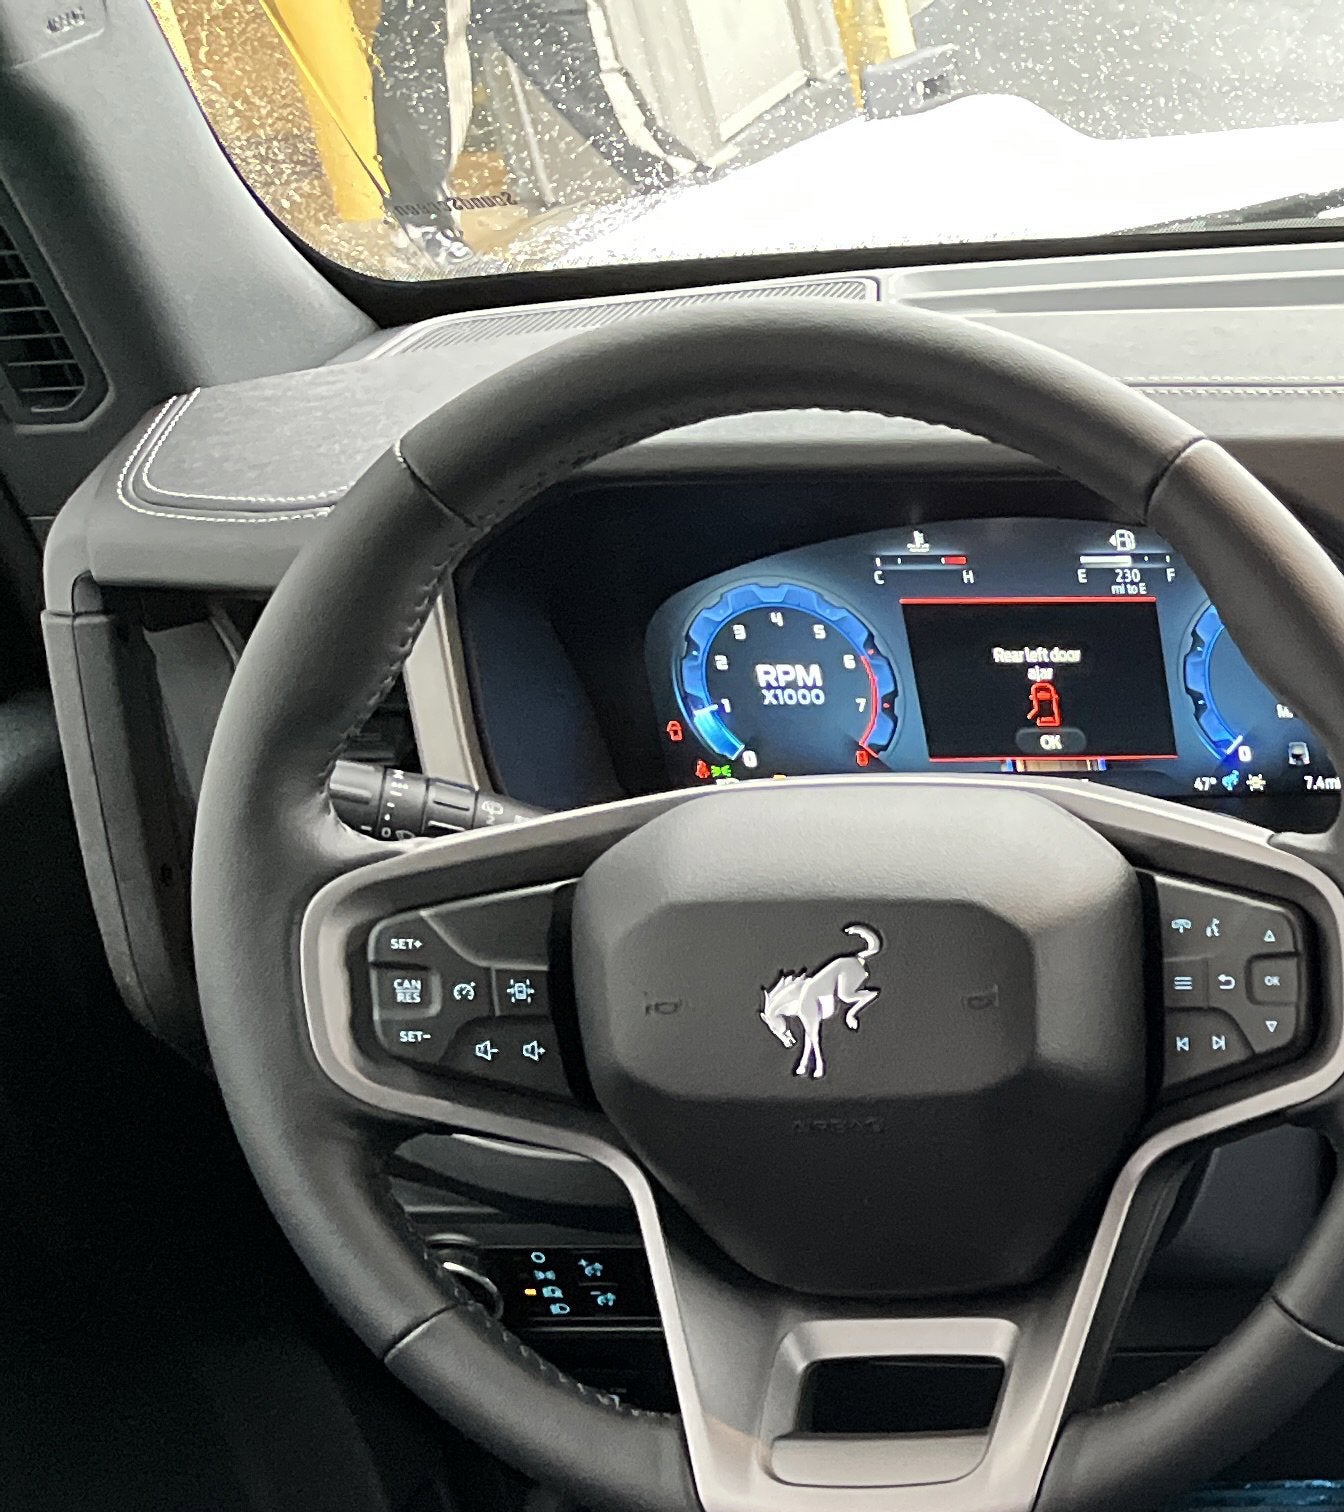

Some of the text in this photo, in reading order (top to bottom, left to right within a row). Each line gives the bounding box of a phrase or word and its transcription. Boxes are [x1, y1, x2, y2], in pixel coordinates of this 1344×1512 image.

[873, 569, 885, 585] C
[962, 569, 975, 584] H
[1077, 569, 1088, 583] E
[1114, 568, 1141, 583] 230
[1166, 568, 1175, 583] F
[1126, 583, 1139, 595] to
[1139, 582, 1147, 595] E
[770, 611, 785, 627] 4
[732, 623, 747, 641] 3
[812, 623, 827, 640] 5
[714, 653, 729, 671] 2
[842, 653, 856, 669] 6
[992, 646, 1081, 663] Rear left door
[755, 663, 824, 688] RPM
[720, 697, 732, 713] 1
[762, 688, 826, 706] X1000
[855, 697, 867, 713] 7
[1038, 734, 1063, 751] OK
[741, 749, 758, 768] 0
[1237, 745, 1252, 762] 0
[393, 978, 422, 990] CAN
[1264, 975, 1281, 987] OK
[395, 992, 422, 1004] RES
